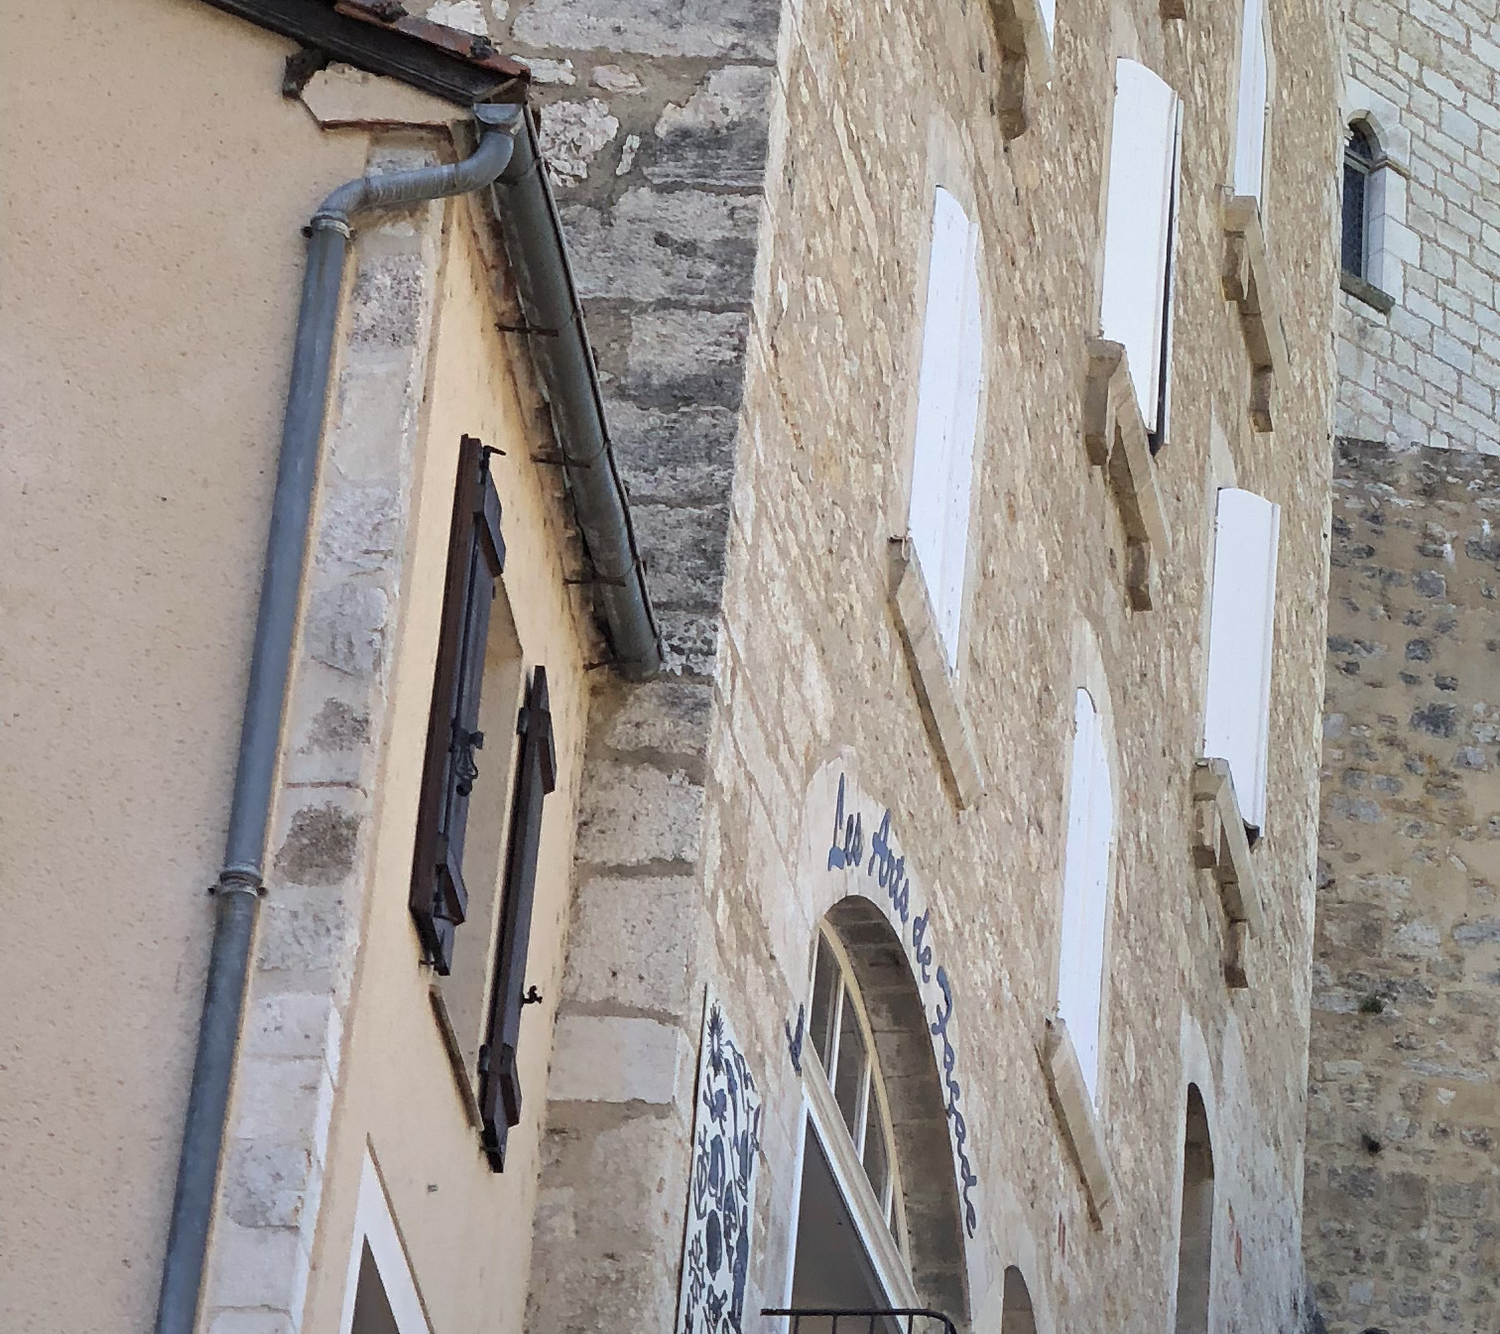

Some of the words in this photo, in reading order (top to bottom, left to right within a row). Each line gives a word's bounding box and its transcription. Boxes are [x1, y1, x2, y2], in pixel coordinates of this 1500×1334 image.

[828, 772, 863, 871] Les
[868, 808, 909, 923] Arts
[913, 908, 932, 984] de
